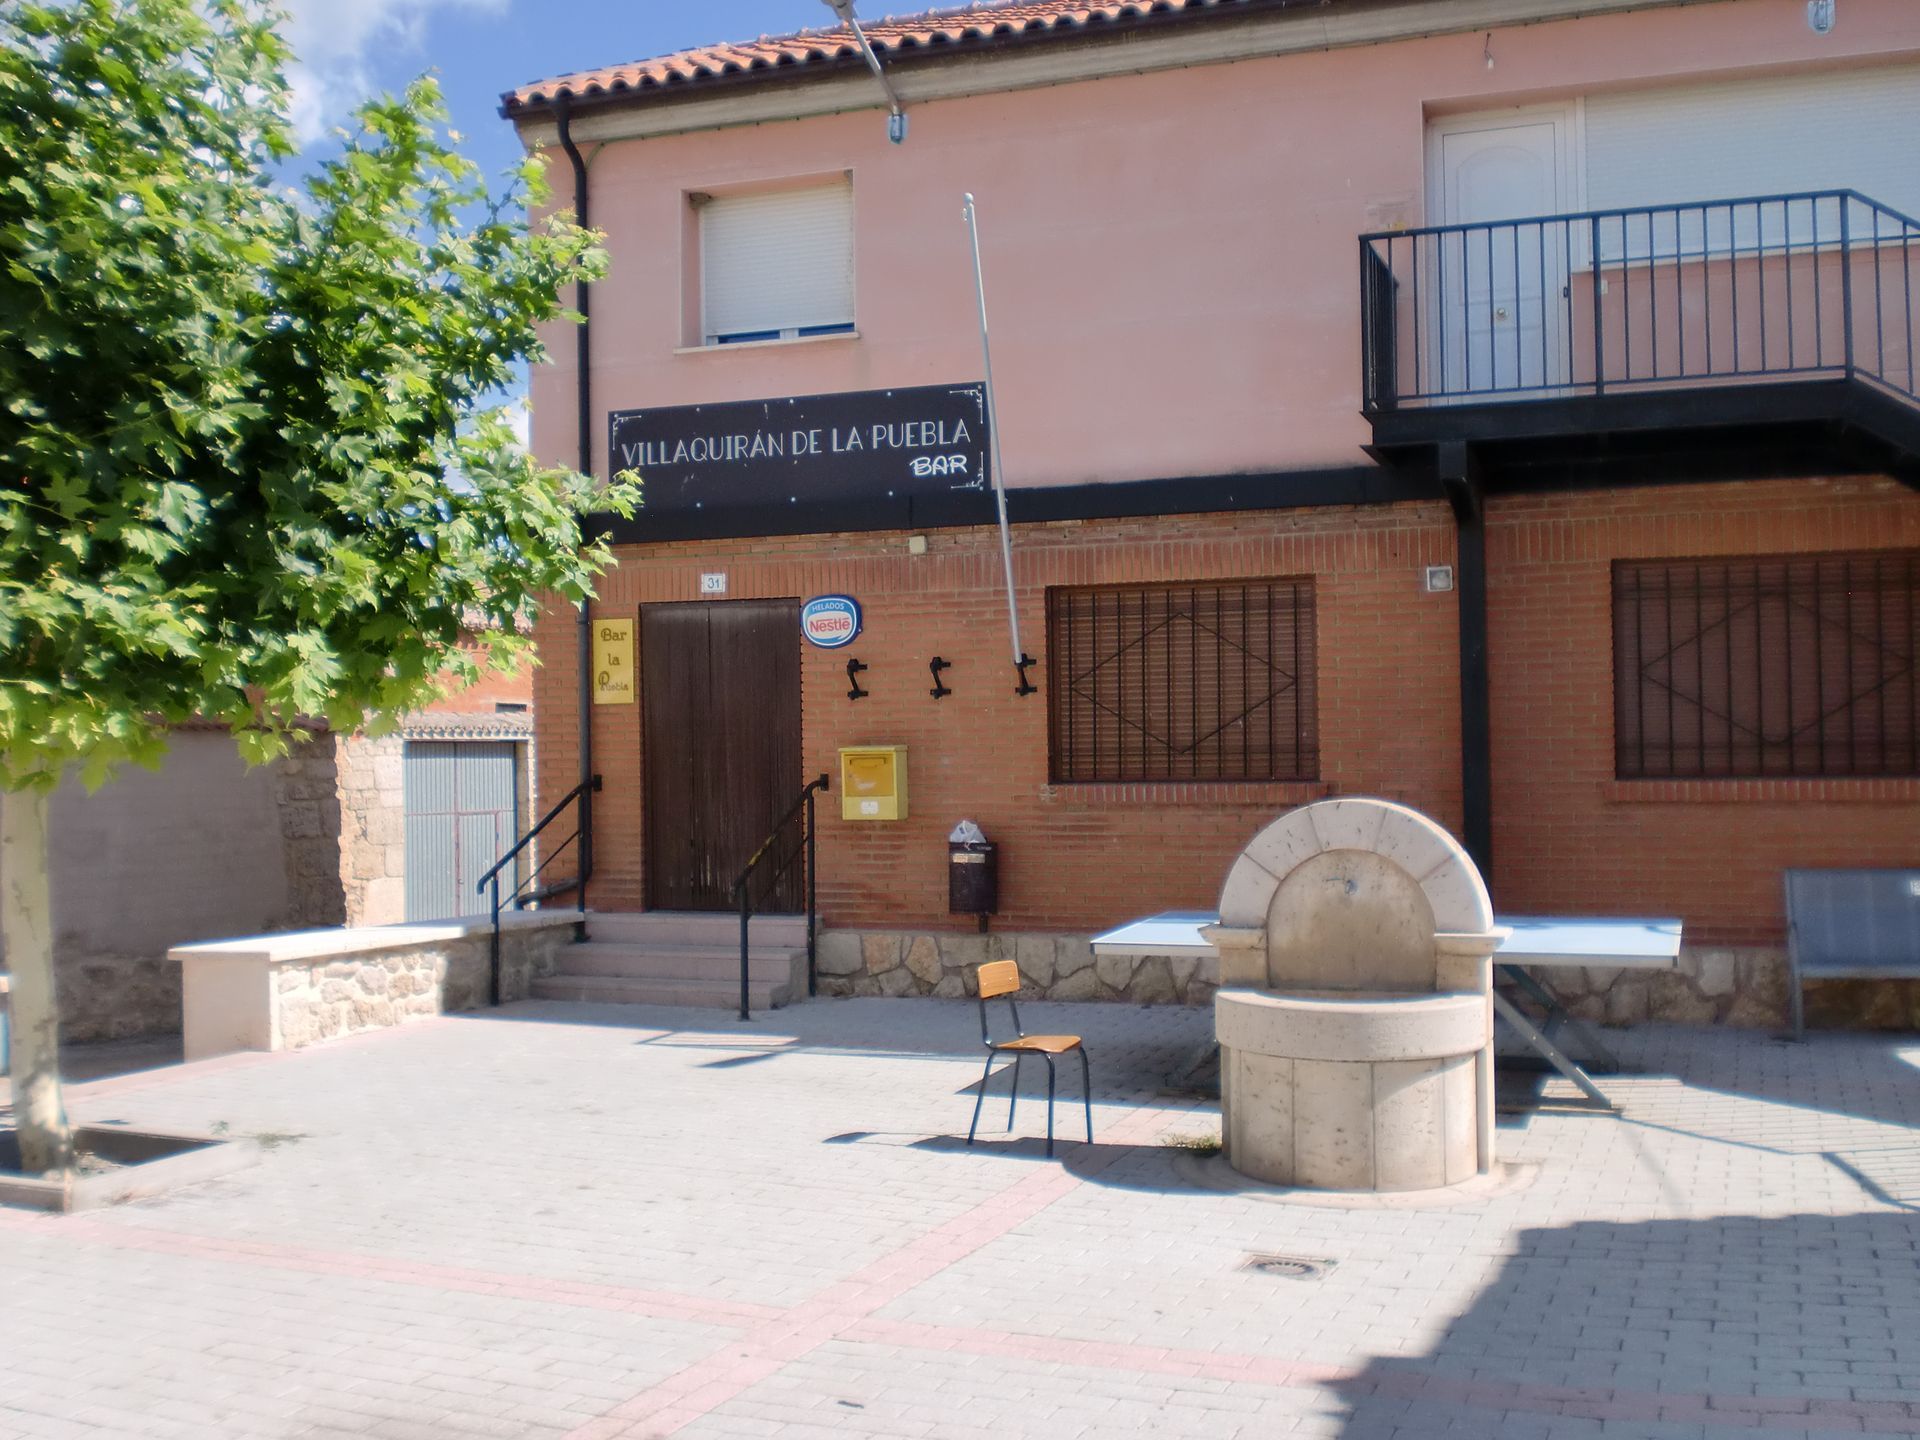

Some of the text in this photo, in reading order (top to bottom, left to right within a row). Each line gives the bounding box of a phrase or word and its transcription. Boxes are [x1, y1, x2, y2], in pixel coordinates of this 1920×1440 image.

[621, 418, 971, 466] VILLAQUIRÁN DE LA PUEBLA
[909, 454, 968, 476] BAR
[707, 577, 720, 589] 31
[809, 617, 850, 633] Nestlé
[600, 627, 627, 642] Bar
[608, 653, 621, 666] la
